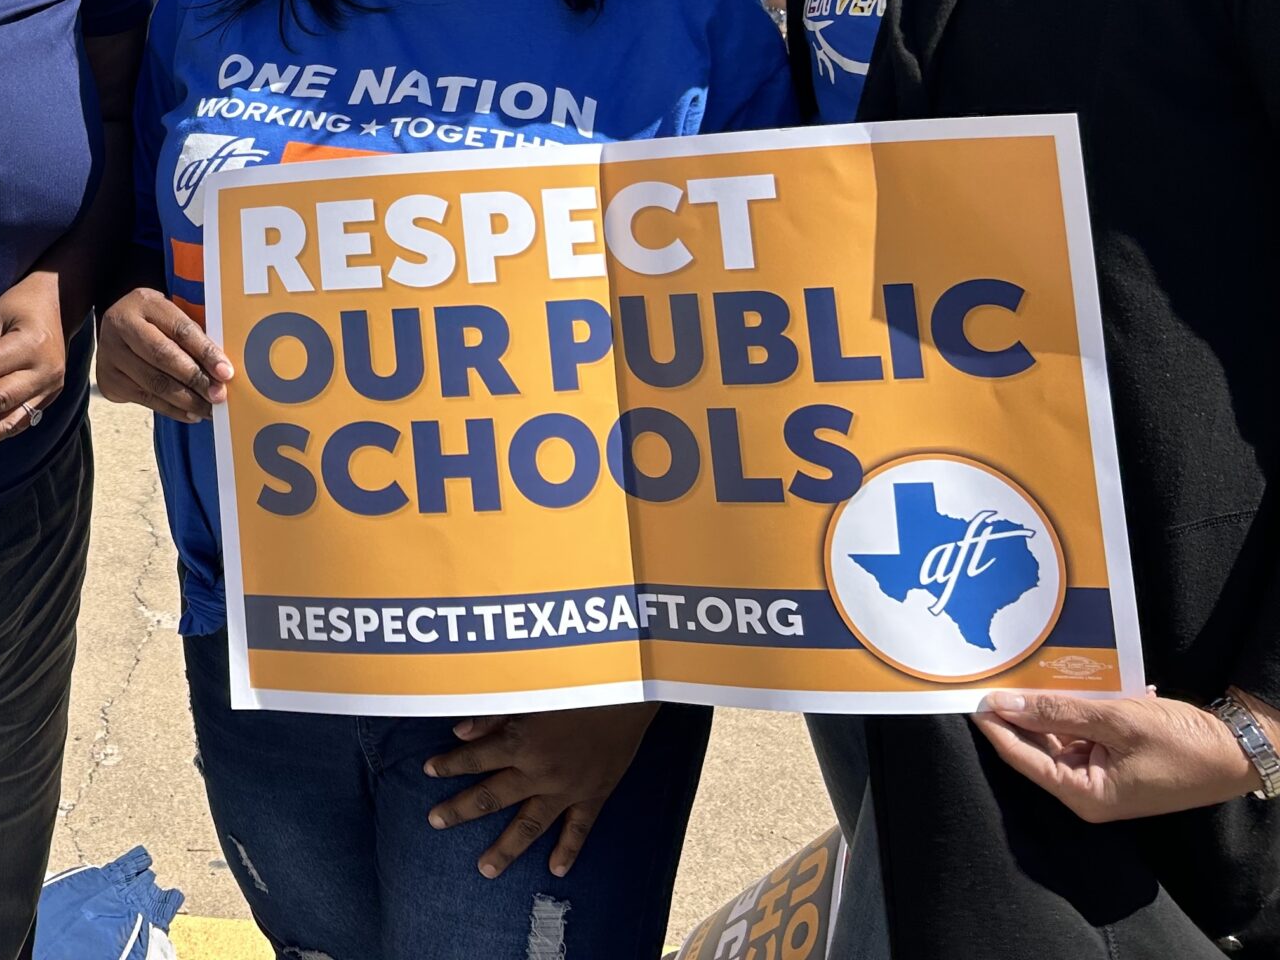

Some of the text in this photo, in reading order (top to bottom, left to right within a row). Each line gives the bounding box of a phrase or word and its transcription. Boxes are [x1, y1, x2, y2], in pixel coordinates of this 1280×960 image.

[196, 97, 352, 133] WORKING
[219, 54, 598, 139] ONE NATION
[239, 173, 776, 295] RESPECT
[243, 278, 1035, 403] OUR PUBLIC
[253, 403, 865, 516] SCHOOLS
[919, 509, 1037, 617] aft
[278, 593, 805, 643] RESPECT.TEXASAFT.ORG
